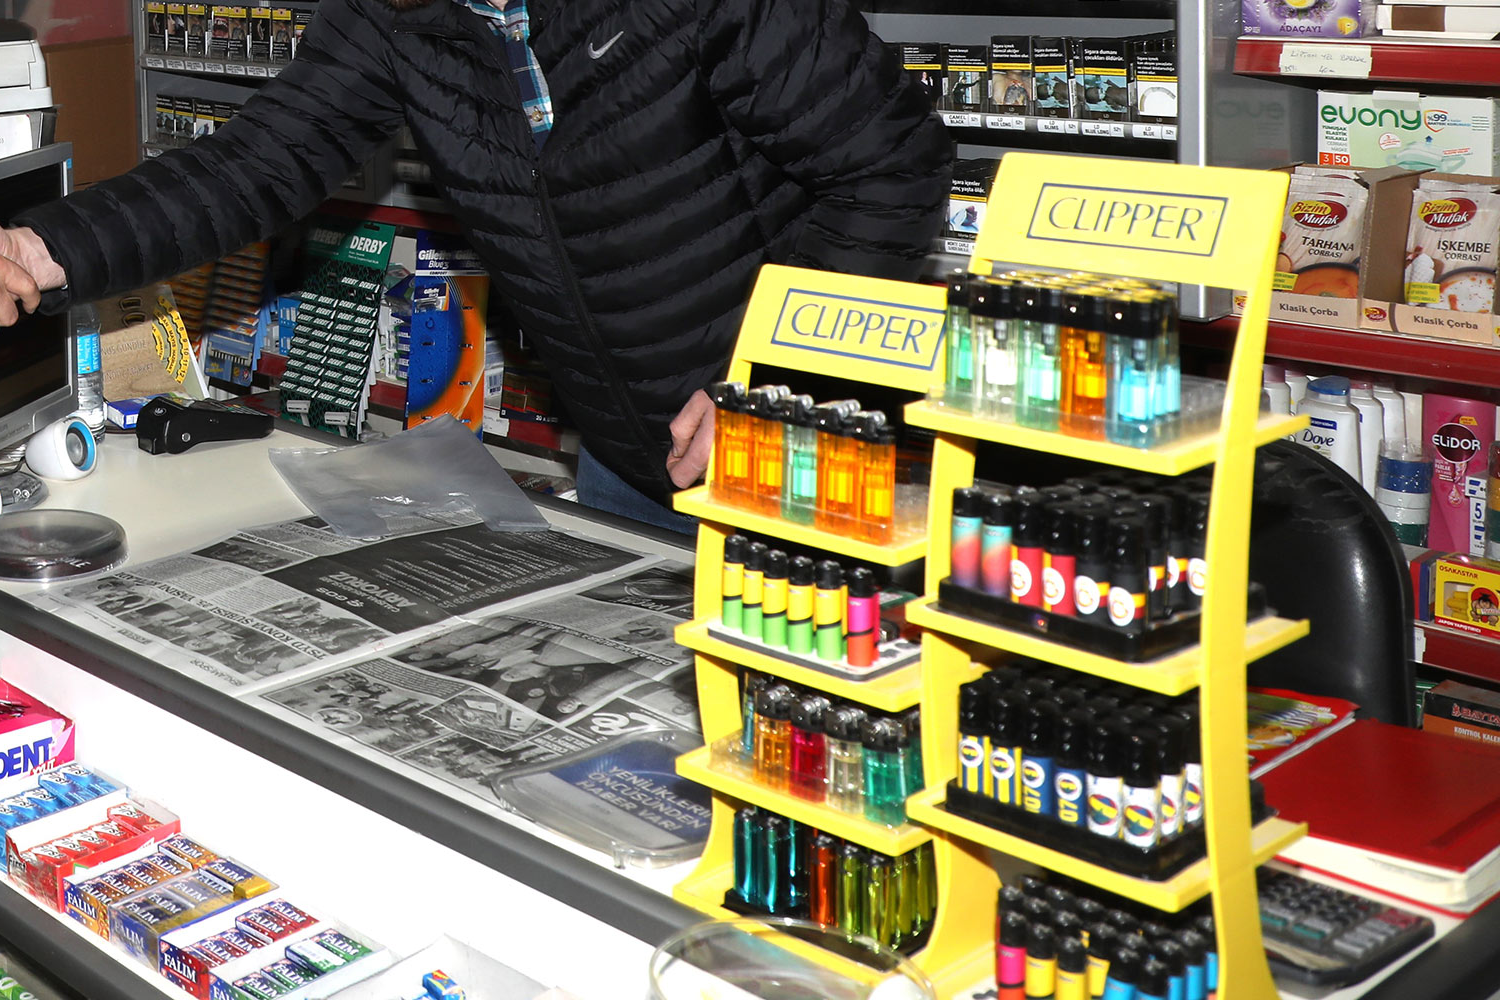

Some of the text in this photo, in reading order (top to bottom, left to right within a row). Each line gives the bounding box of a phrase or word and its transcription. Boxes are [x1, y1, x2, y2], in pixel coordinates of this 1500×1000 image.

[1280, 23, 1321, 33] ADAÇAYI
[1321, 105, 1421, 130] evony
[1323, 154, 1329, 162] 3
[1335, 155, 1348, 163] 50
[1048, 196, 1204, 242] CLIPPER
[1299, 213, 1339, 226] Mutfak
[350, 235, 387, 255] DERBY
[1301, 236, 1354, 251] TARHANA
[1308, 248, 1343, 258] ÇORBASI
[1444, 252, 1481, 262] ÇORBASI
[341, 276, 376, 290] DERBY DERBY
[1280, 303, 1338, 317] Klasik Çorba
[790, 302, 928, 355] CLIPPER
[1414, 315, 1478, 330] Klasik Çorba
[1303, 429, 1334, 447] Dove
[1439, 565, 1478, 579] OSAKASTAR
[251, 620, 293, 642] KONYA
[575, 780, 638, 811] HABER
[169, 839, 203, 859] FALIM
[66, 891, 96, 918] FALIM
[323, 934, 360, 956] FALIM
[164, 952, 196, 983] FALIM
